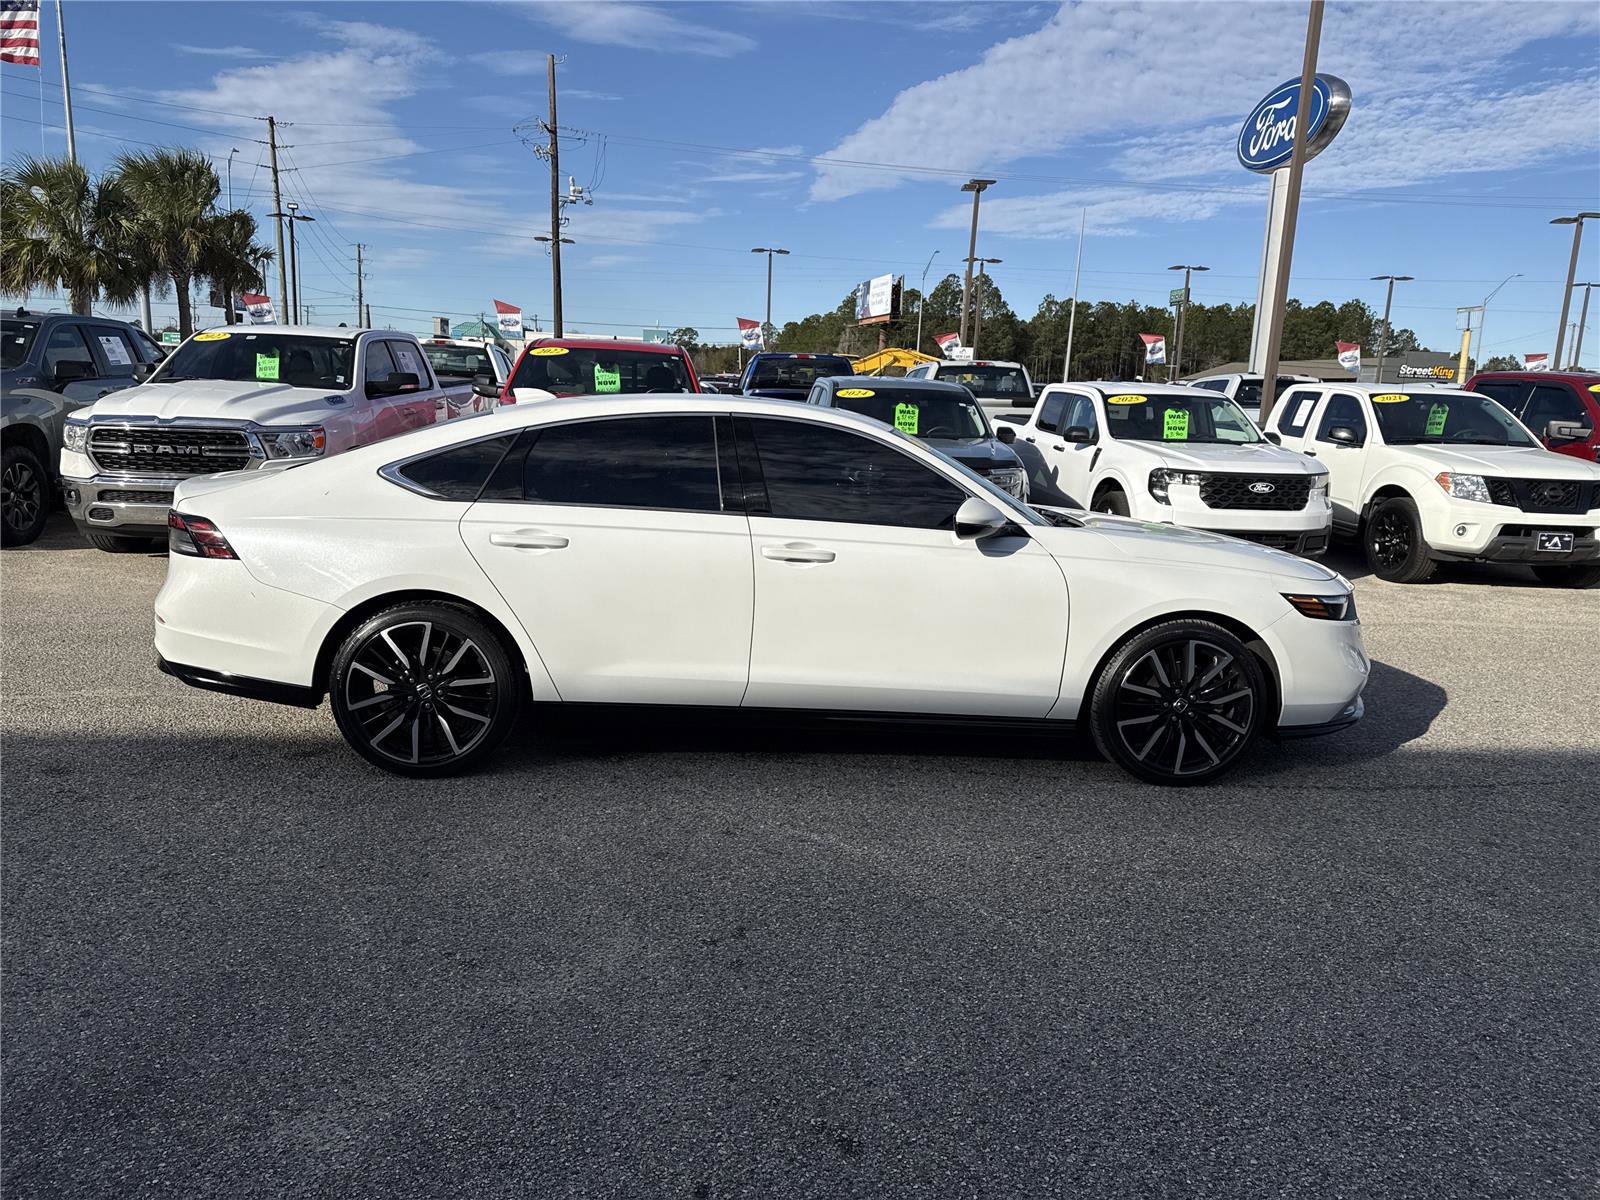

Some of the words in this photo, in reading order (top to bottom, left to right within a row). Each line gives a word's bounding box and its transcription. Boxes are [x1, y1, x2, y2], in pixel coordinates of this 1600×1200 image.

[1399, 364, 1455, 379] StreetKing
[133, 444, 199, 455] RAM
[1253, 483, 1271, 492] Ford
